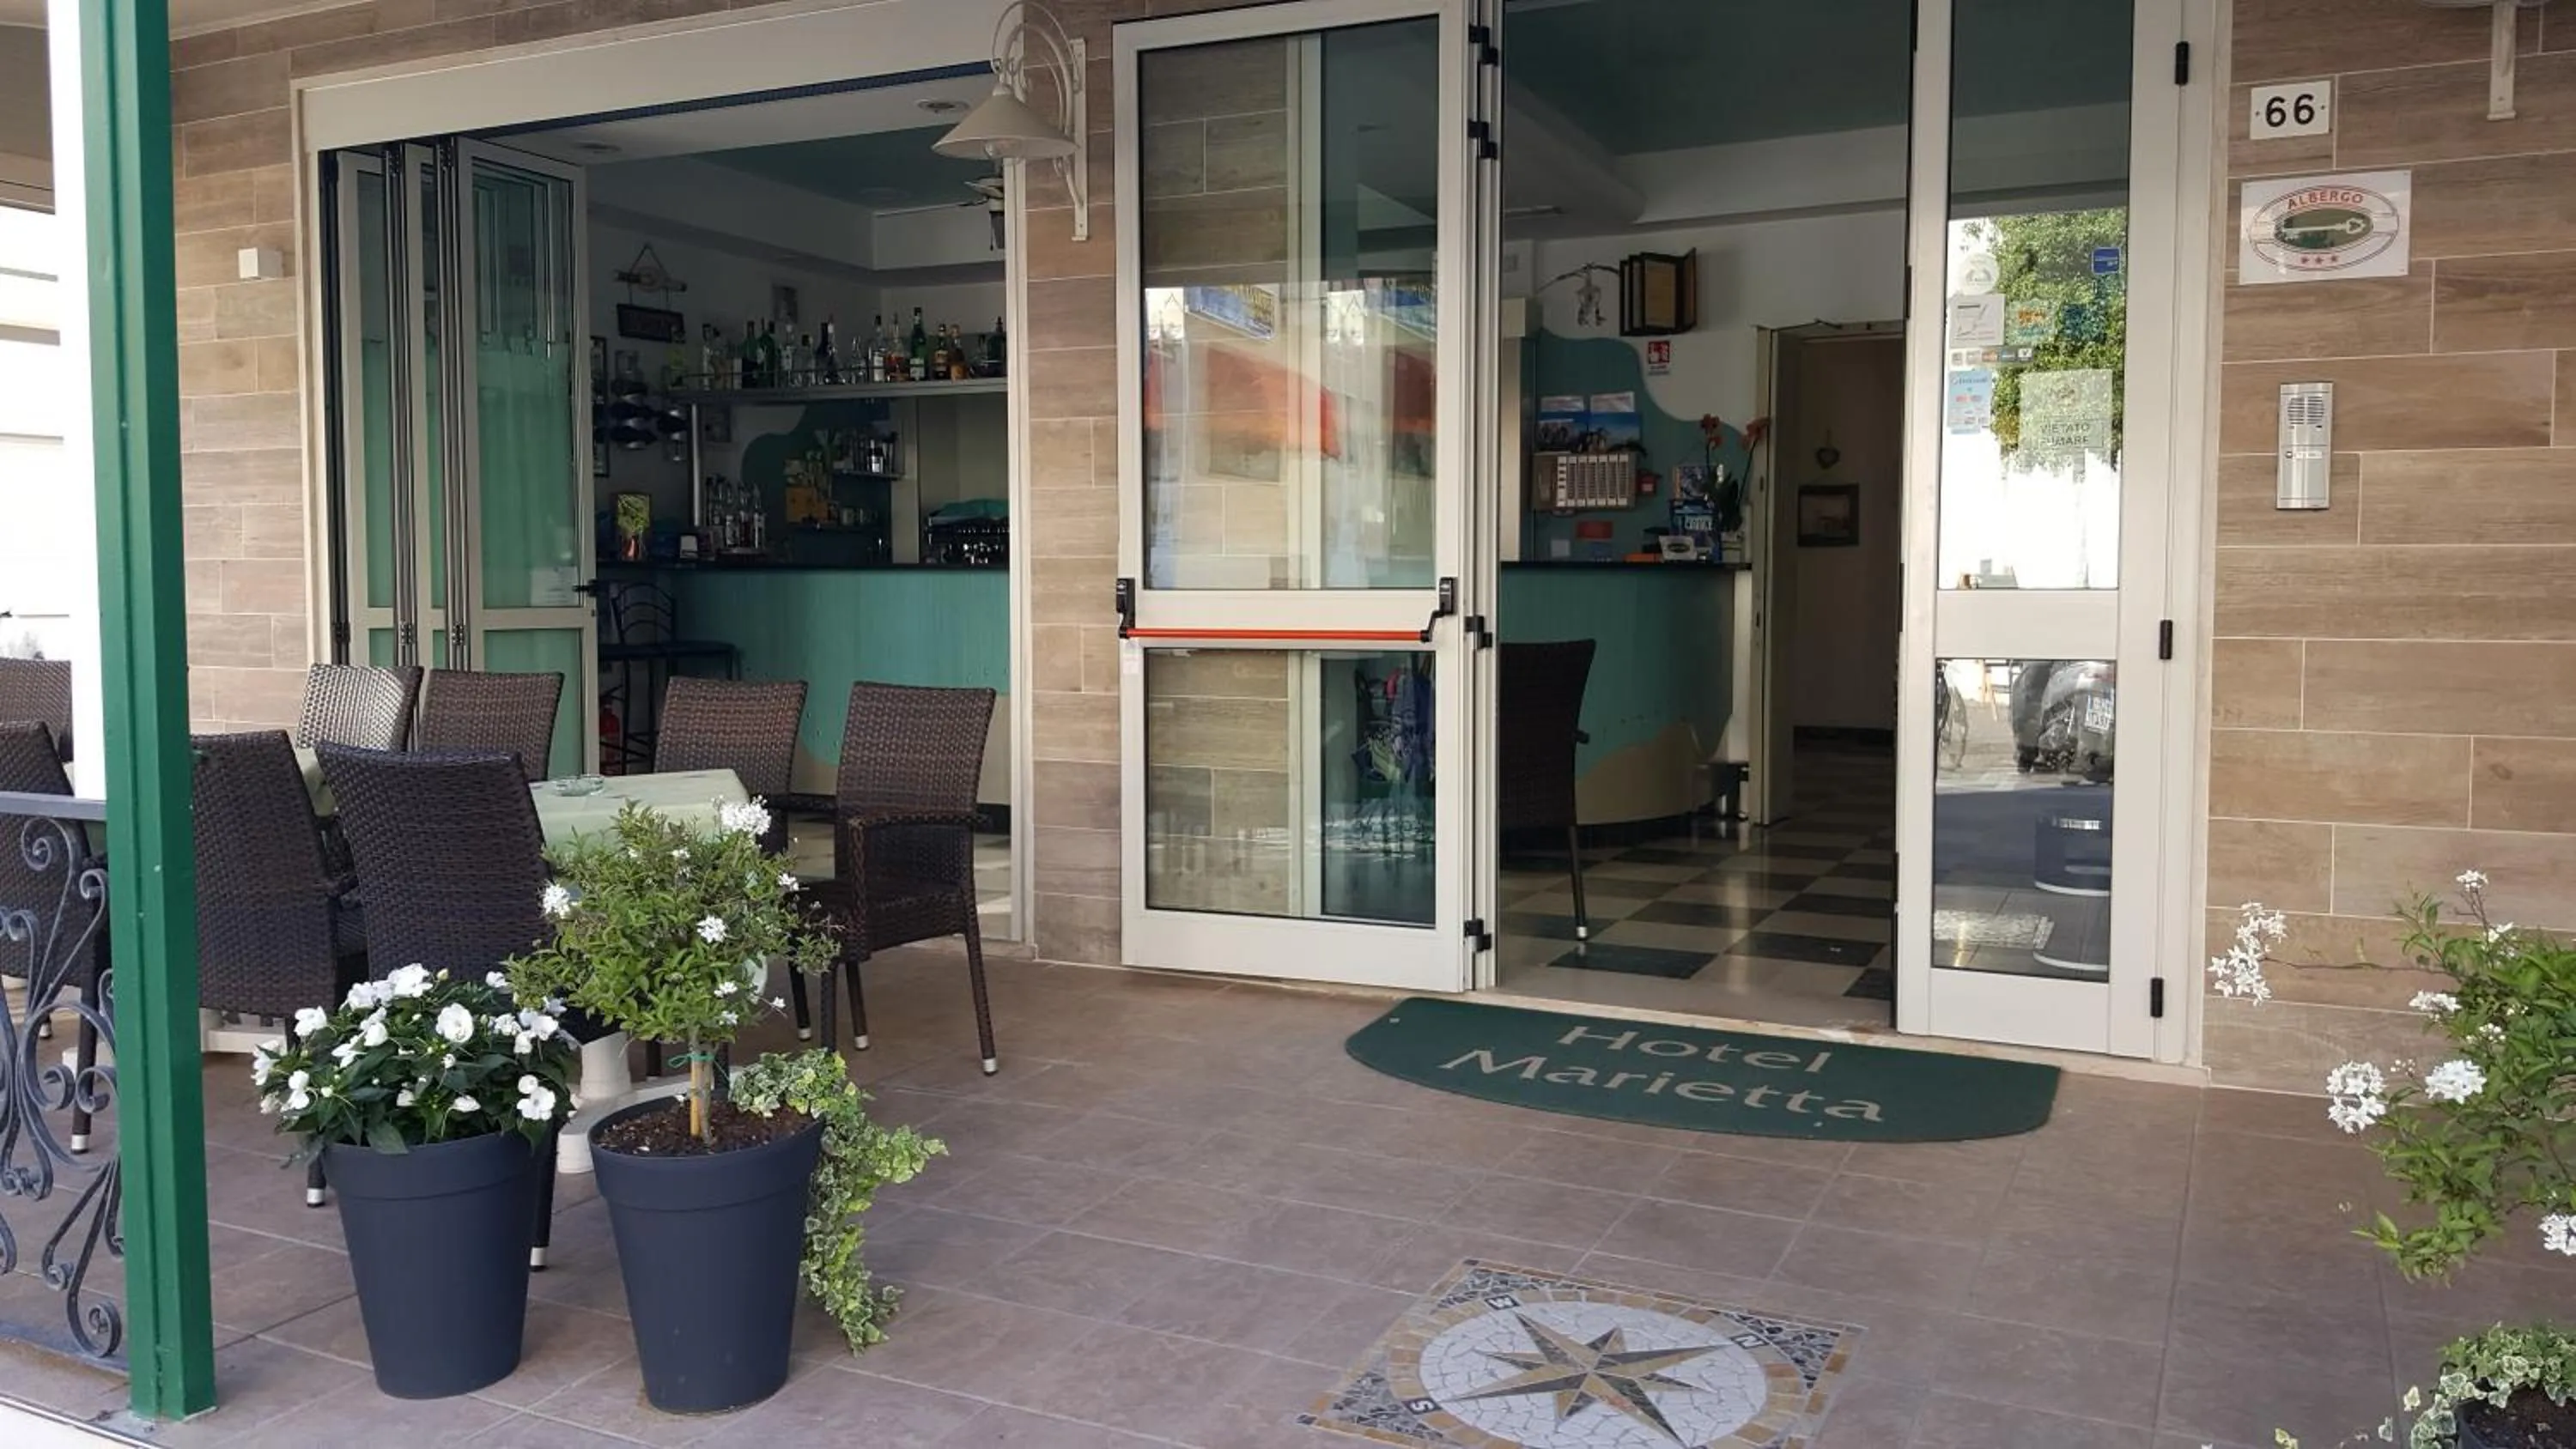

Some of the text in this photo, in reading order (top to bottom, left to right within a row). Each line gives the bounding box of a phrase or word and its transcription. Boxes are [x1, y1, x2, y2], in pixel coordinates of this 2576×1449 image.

[2265, 94, 2315, 127] 66
[2287, 190, 2365, 210] ALBERGO
[2039, 422, 2090, 434] VIETATO
[1557, 1026, 1832, 1072] Hotel
[1437, 1048, 1884, 1123] Marietta
[1408, 1399, 1437, 1413] S
